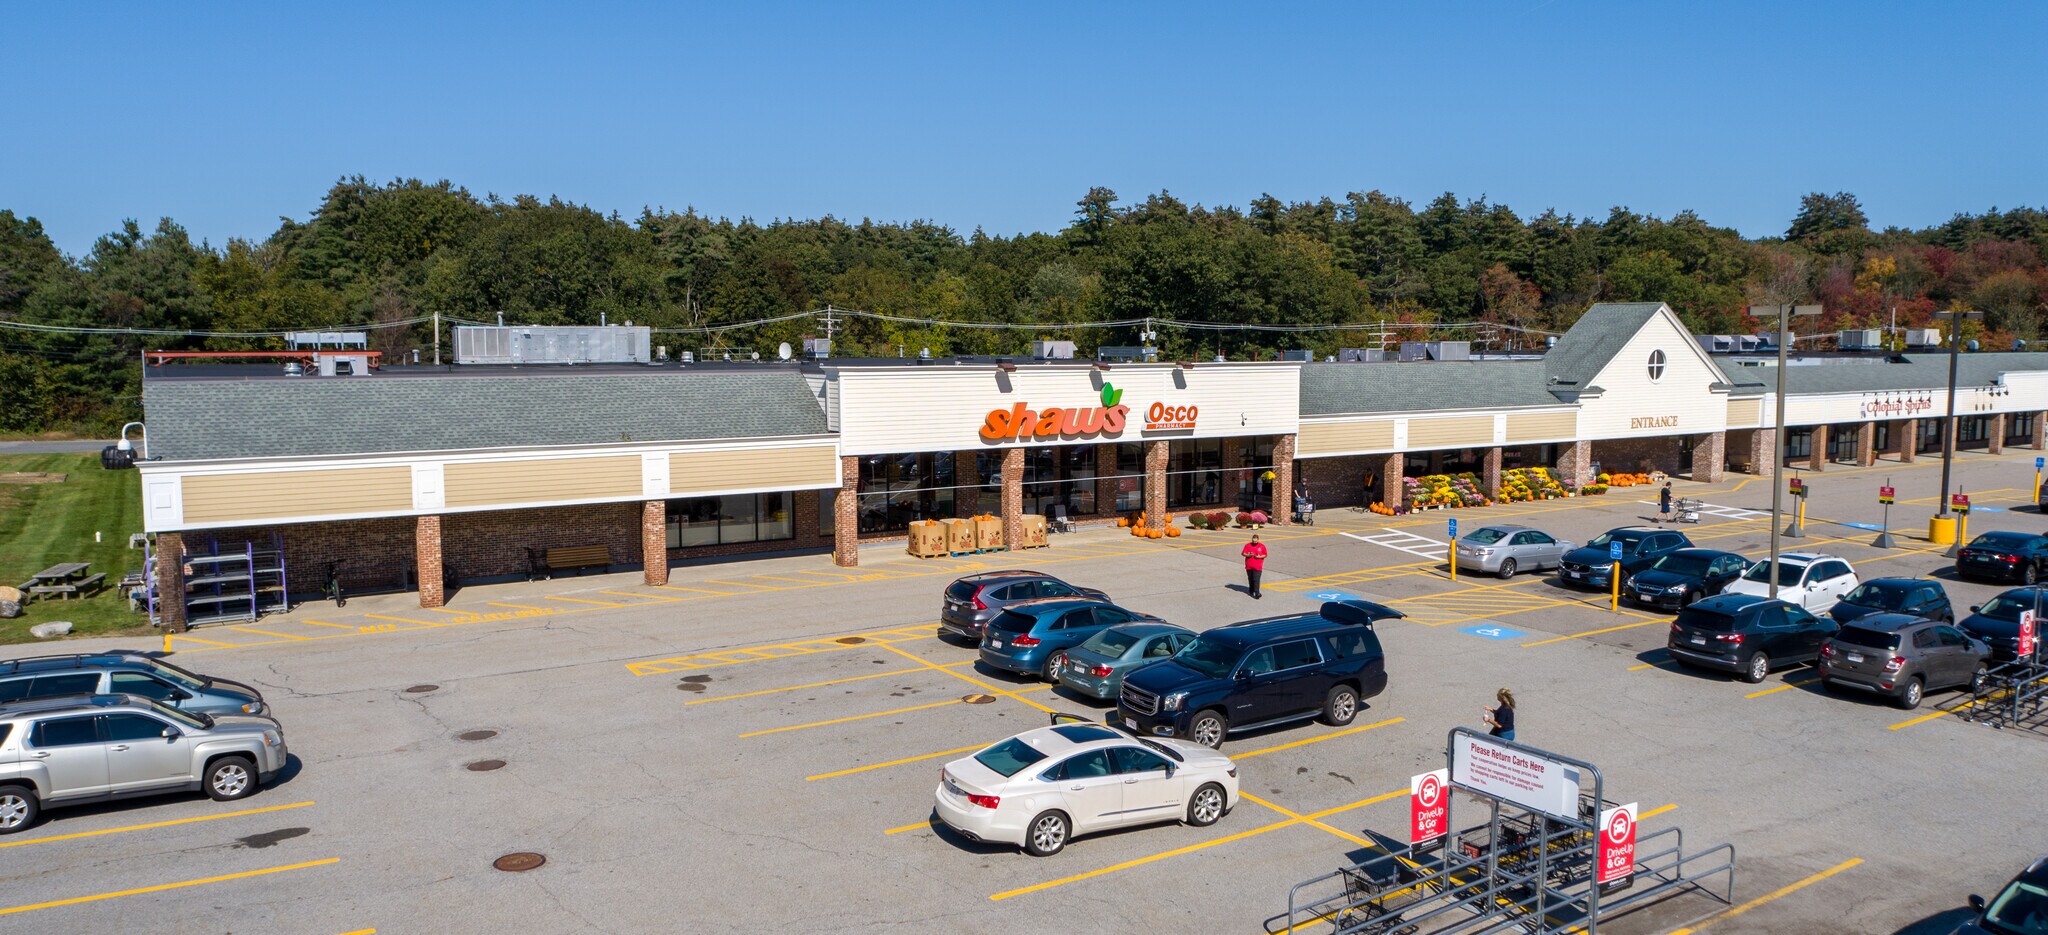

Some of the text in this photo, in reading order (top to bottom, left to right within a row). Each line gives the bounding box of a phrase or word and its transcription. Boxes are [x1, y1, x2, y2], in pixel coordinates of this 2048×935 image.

[1149, 401, 1199, 423] Osco
[1866, 399, 1932, 413] Colonial Spirits
[1155, 422, 1187, 430] PHARMACY
[1630, 415, 1678, 429] ENTRANCE
[1471, 743, 1544, 773] Please Return Carts Here
[1515, 782, 1528, 790] parking
[1418, 806, 1443, 820] DriveUp
[1419, 822, 1424, 830] &
[1607, 844, 1633, 858] DriveUp
[1607, 859, 1613, 868] &
